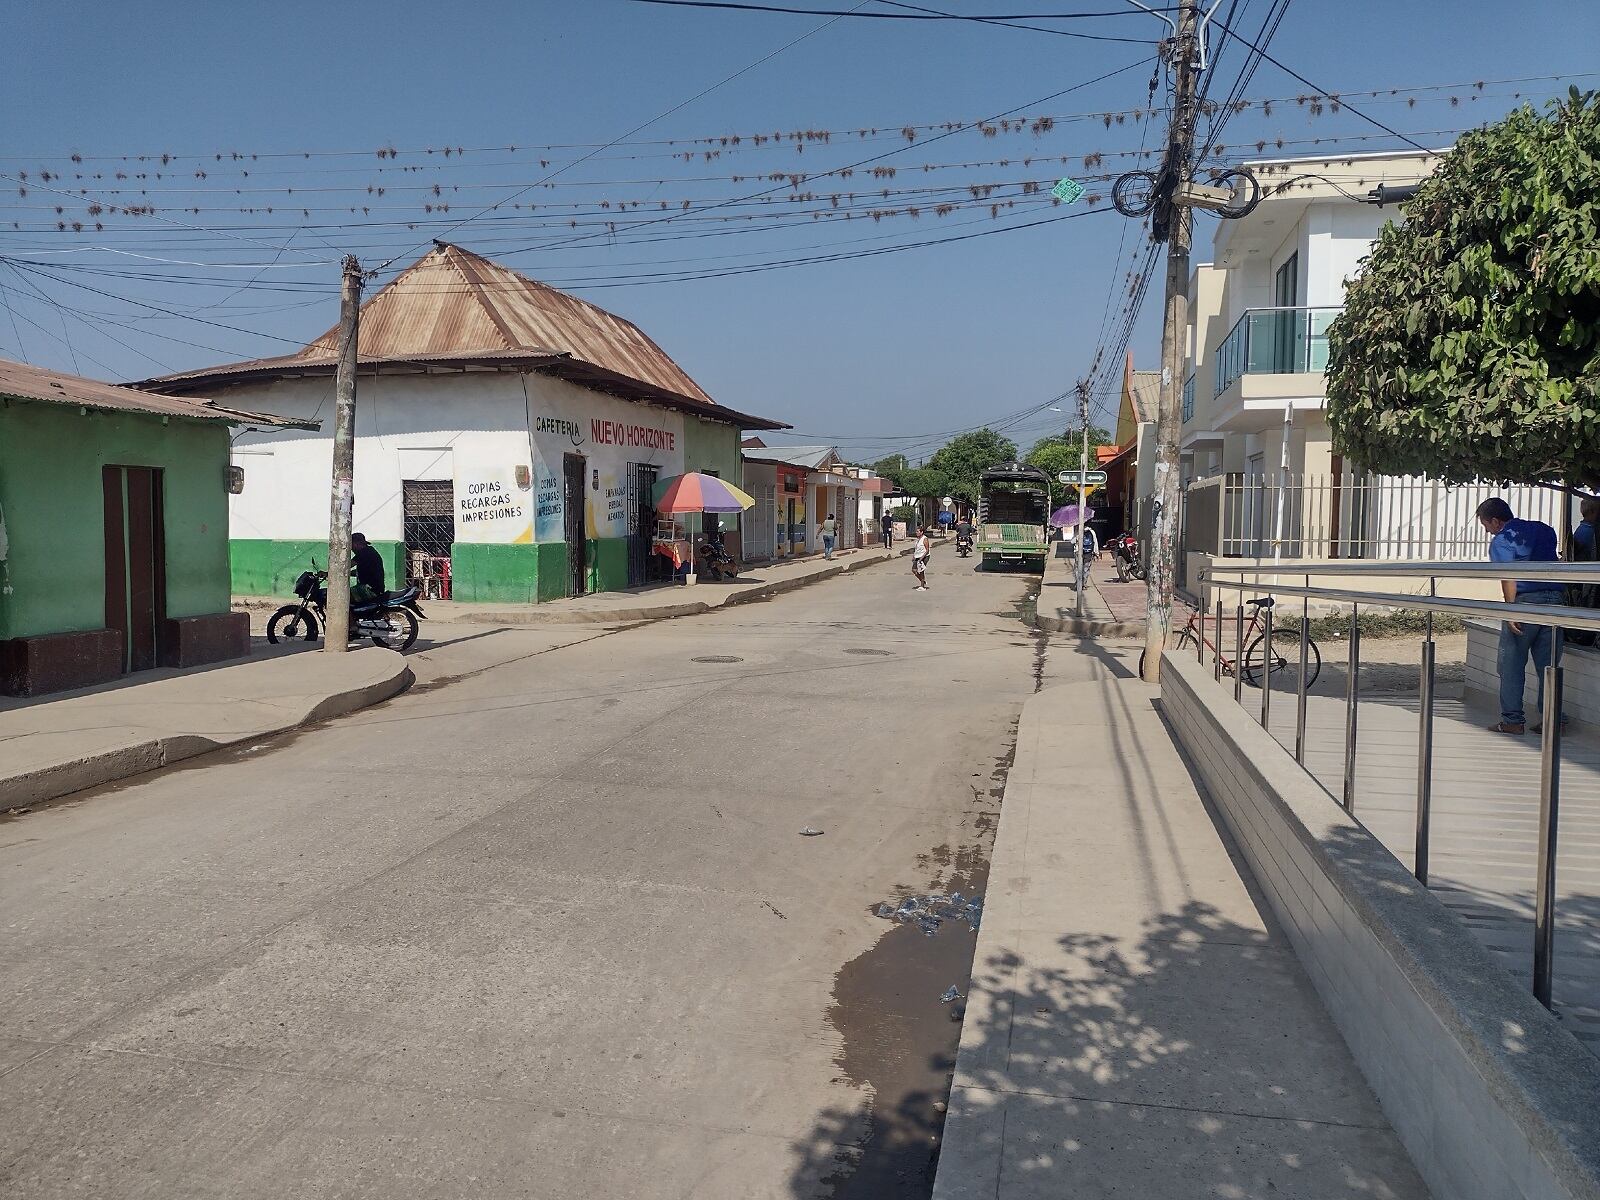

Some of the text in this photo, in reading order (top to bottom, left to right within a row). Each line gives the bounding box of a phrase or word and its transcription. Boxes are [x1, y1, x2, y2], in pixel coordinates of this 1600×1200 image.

[536, 416, 585, 446] CAFETERIA
[591, 418, 675, 451] NUEVO HORIZONTE
[468, 481, 501, 495] COPIAS
[461, 493, 511, 510] RECARGAS
[462, 506, 522, 523] IMPRESIONES
